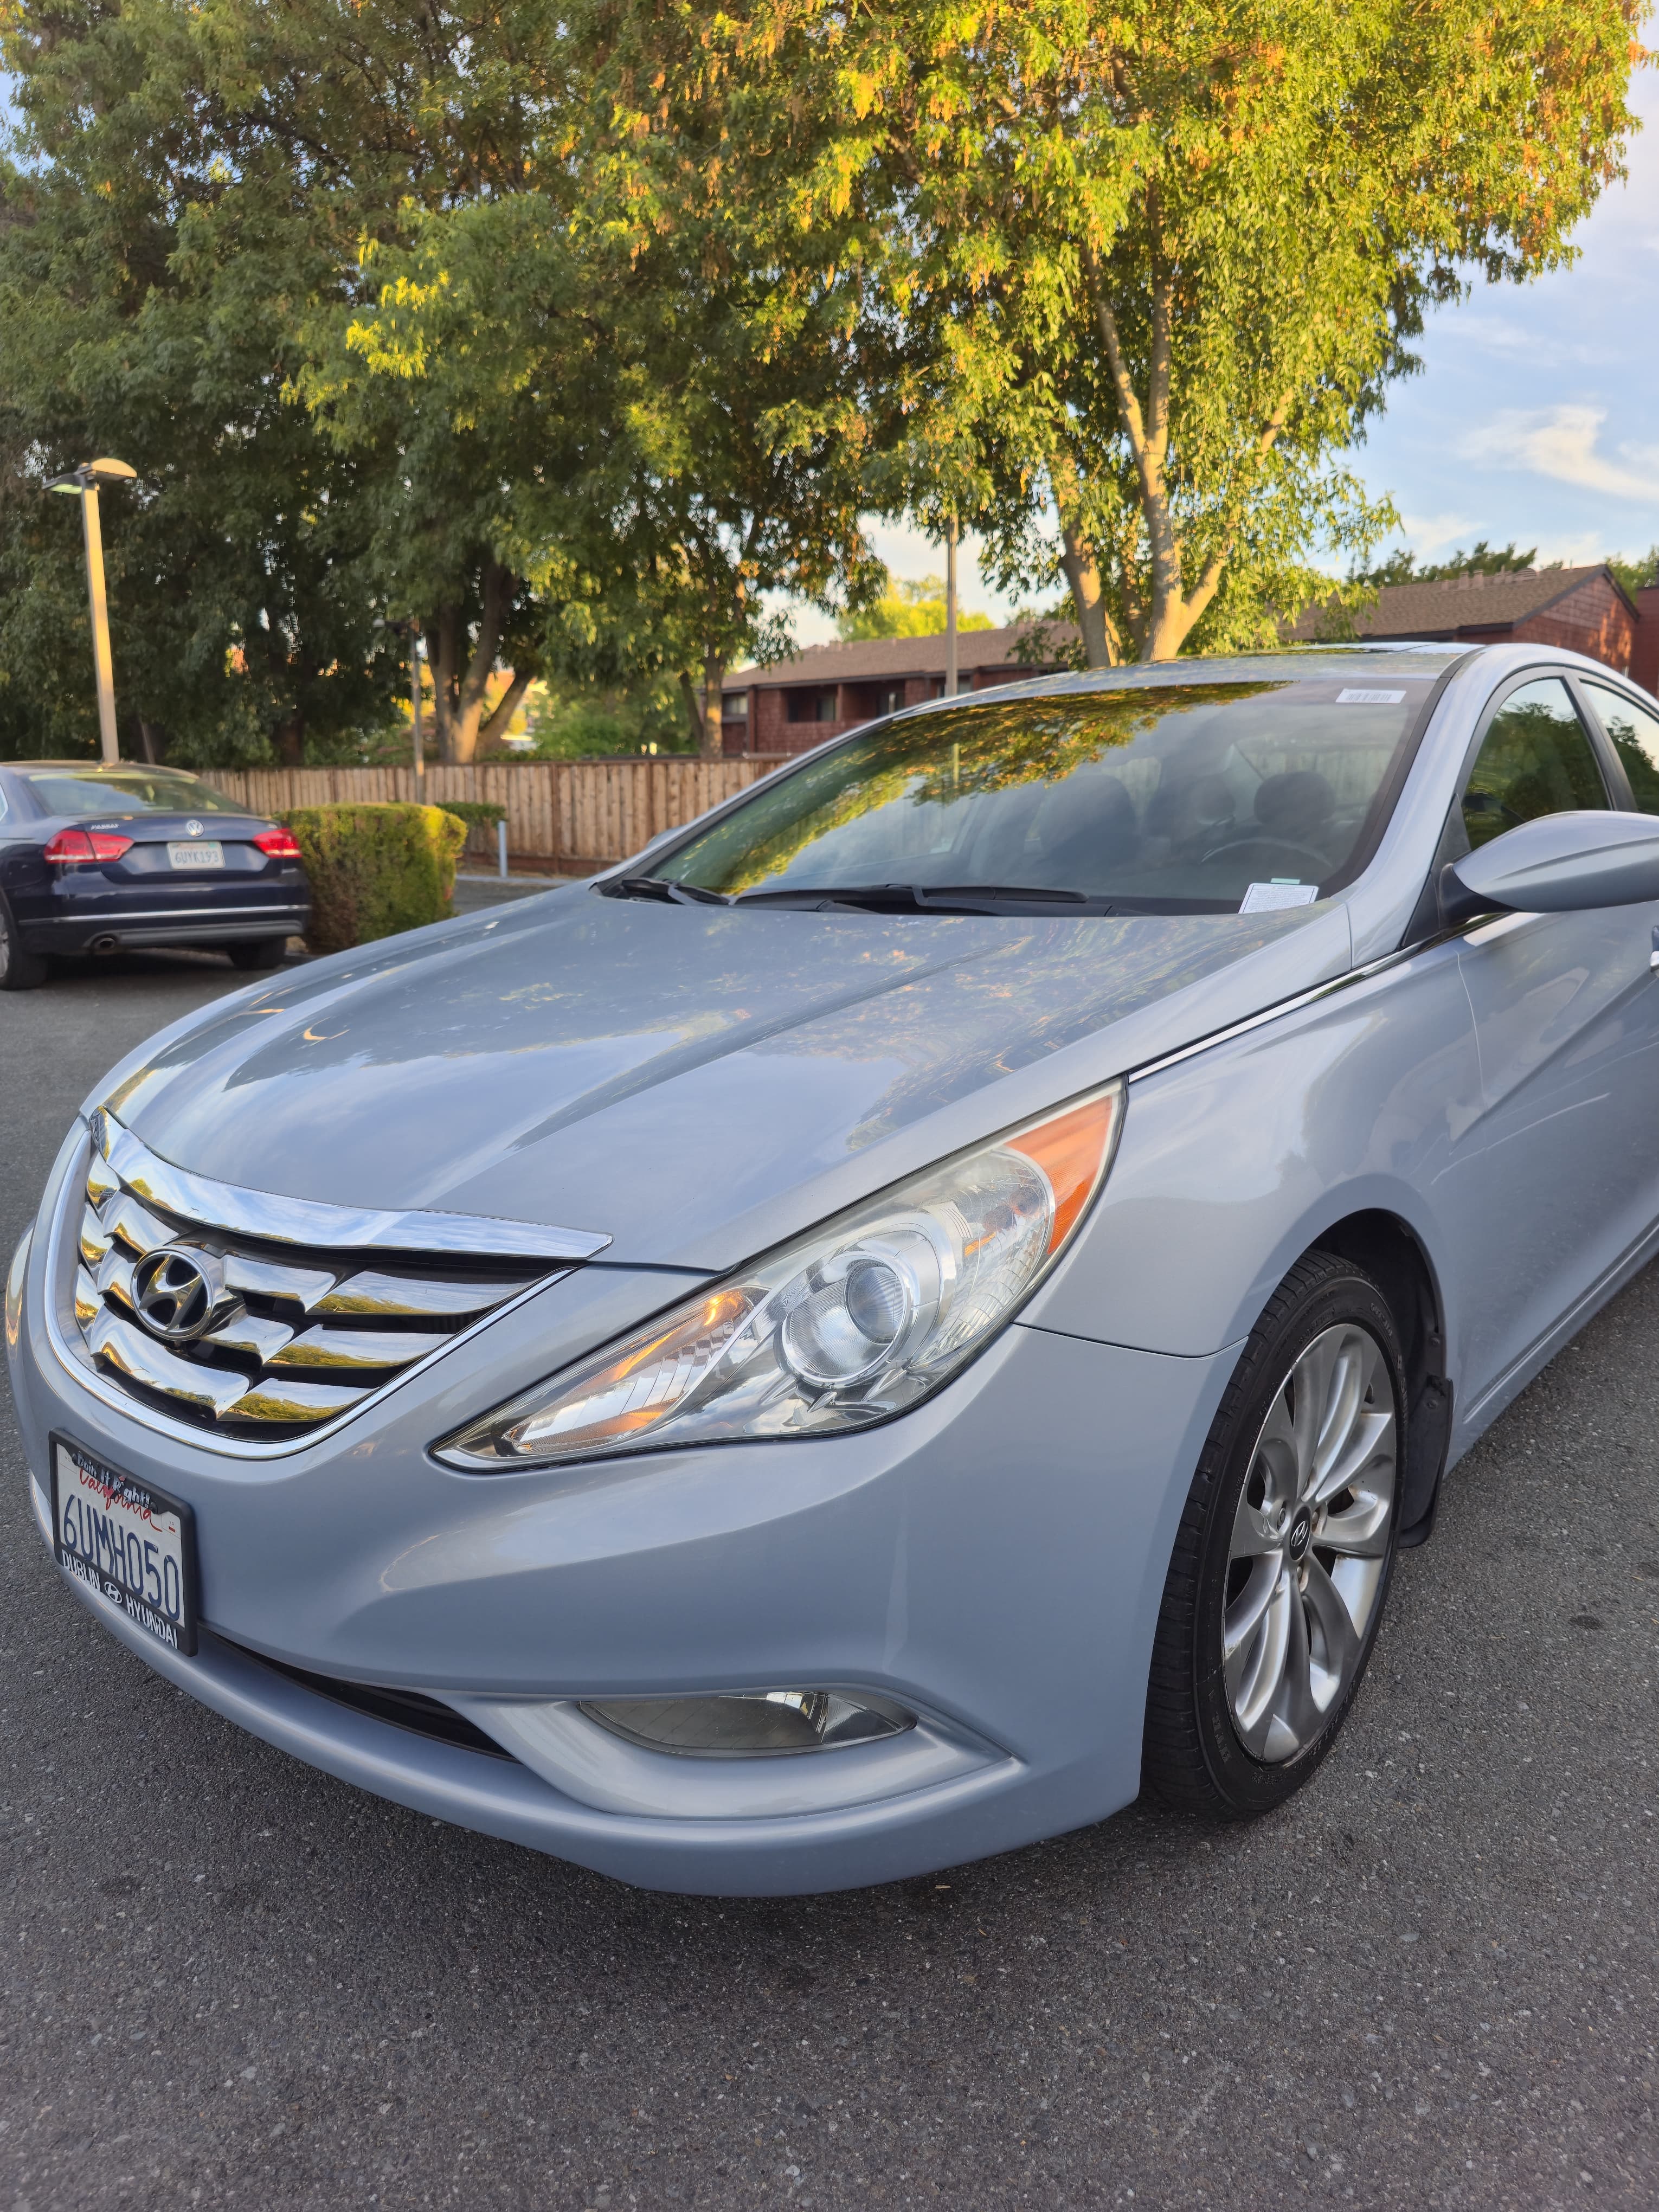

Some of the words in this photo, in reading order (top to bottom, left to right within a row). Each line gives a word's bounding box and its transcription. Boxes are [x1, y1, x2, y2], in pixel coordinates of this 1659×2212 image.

[62, 1548, 102, 1593] DUBLIN
[125, 1592, 178, 1650] HYUNDAI
[63, 1494, 180, 1622] 6UMH050
